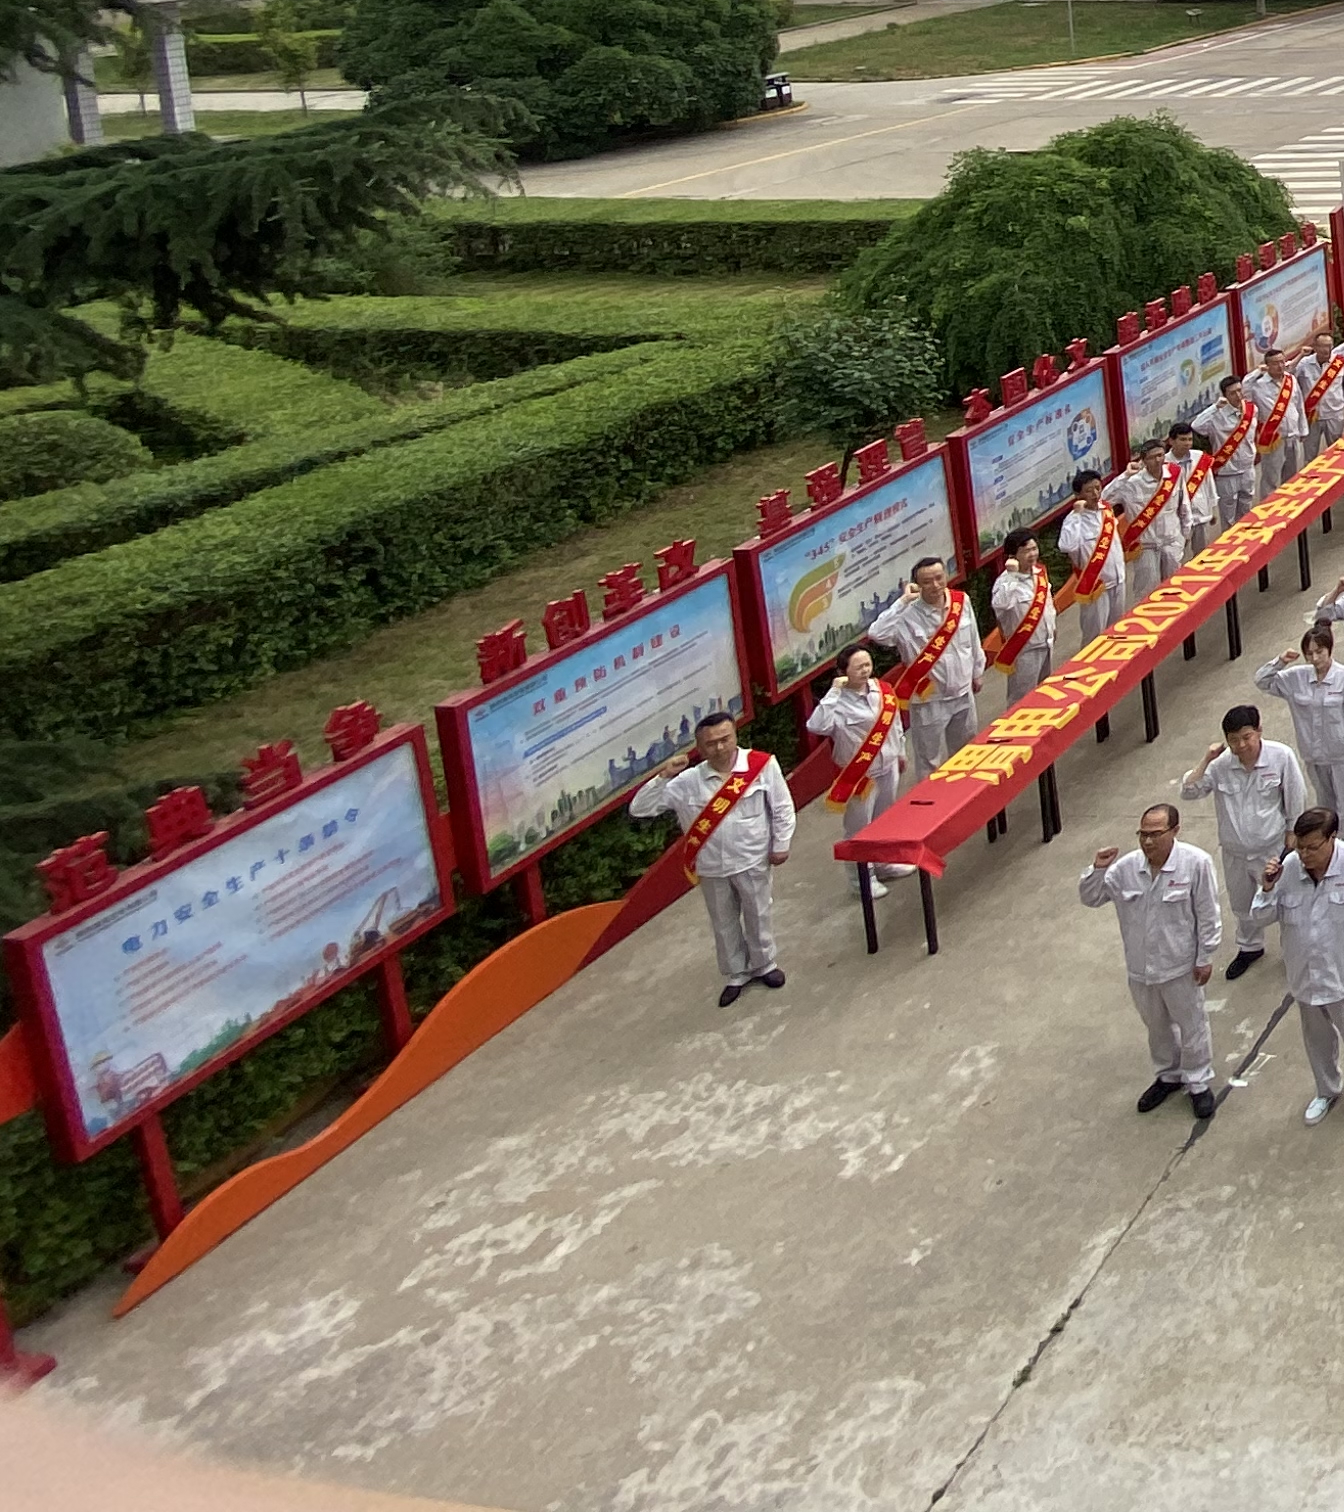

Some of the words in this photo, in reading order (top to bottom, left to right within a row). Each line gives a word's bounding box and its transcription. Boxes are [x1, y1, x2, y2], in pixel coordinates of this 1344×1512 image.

[918, 602, 961, 665] 安全生产
[854, 693, 897, 763] 文明生产
